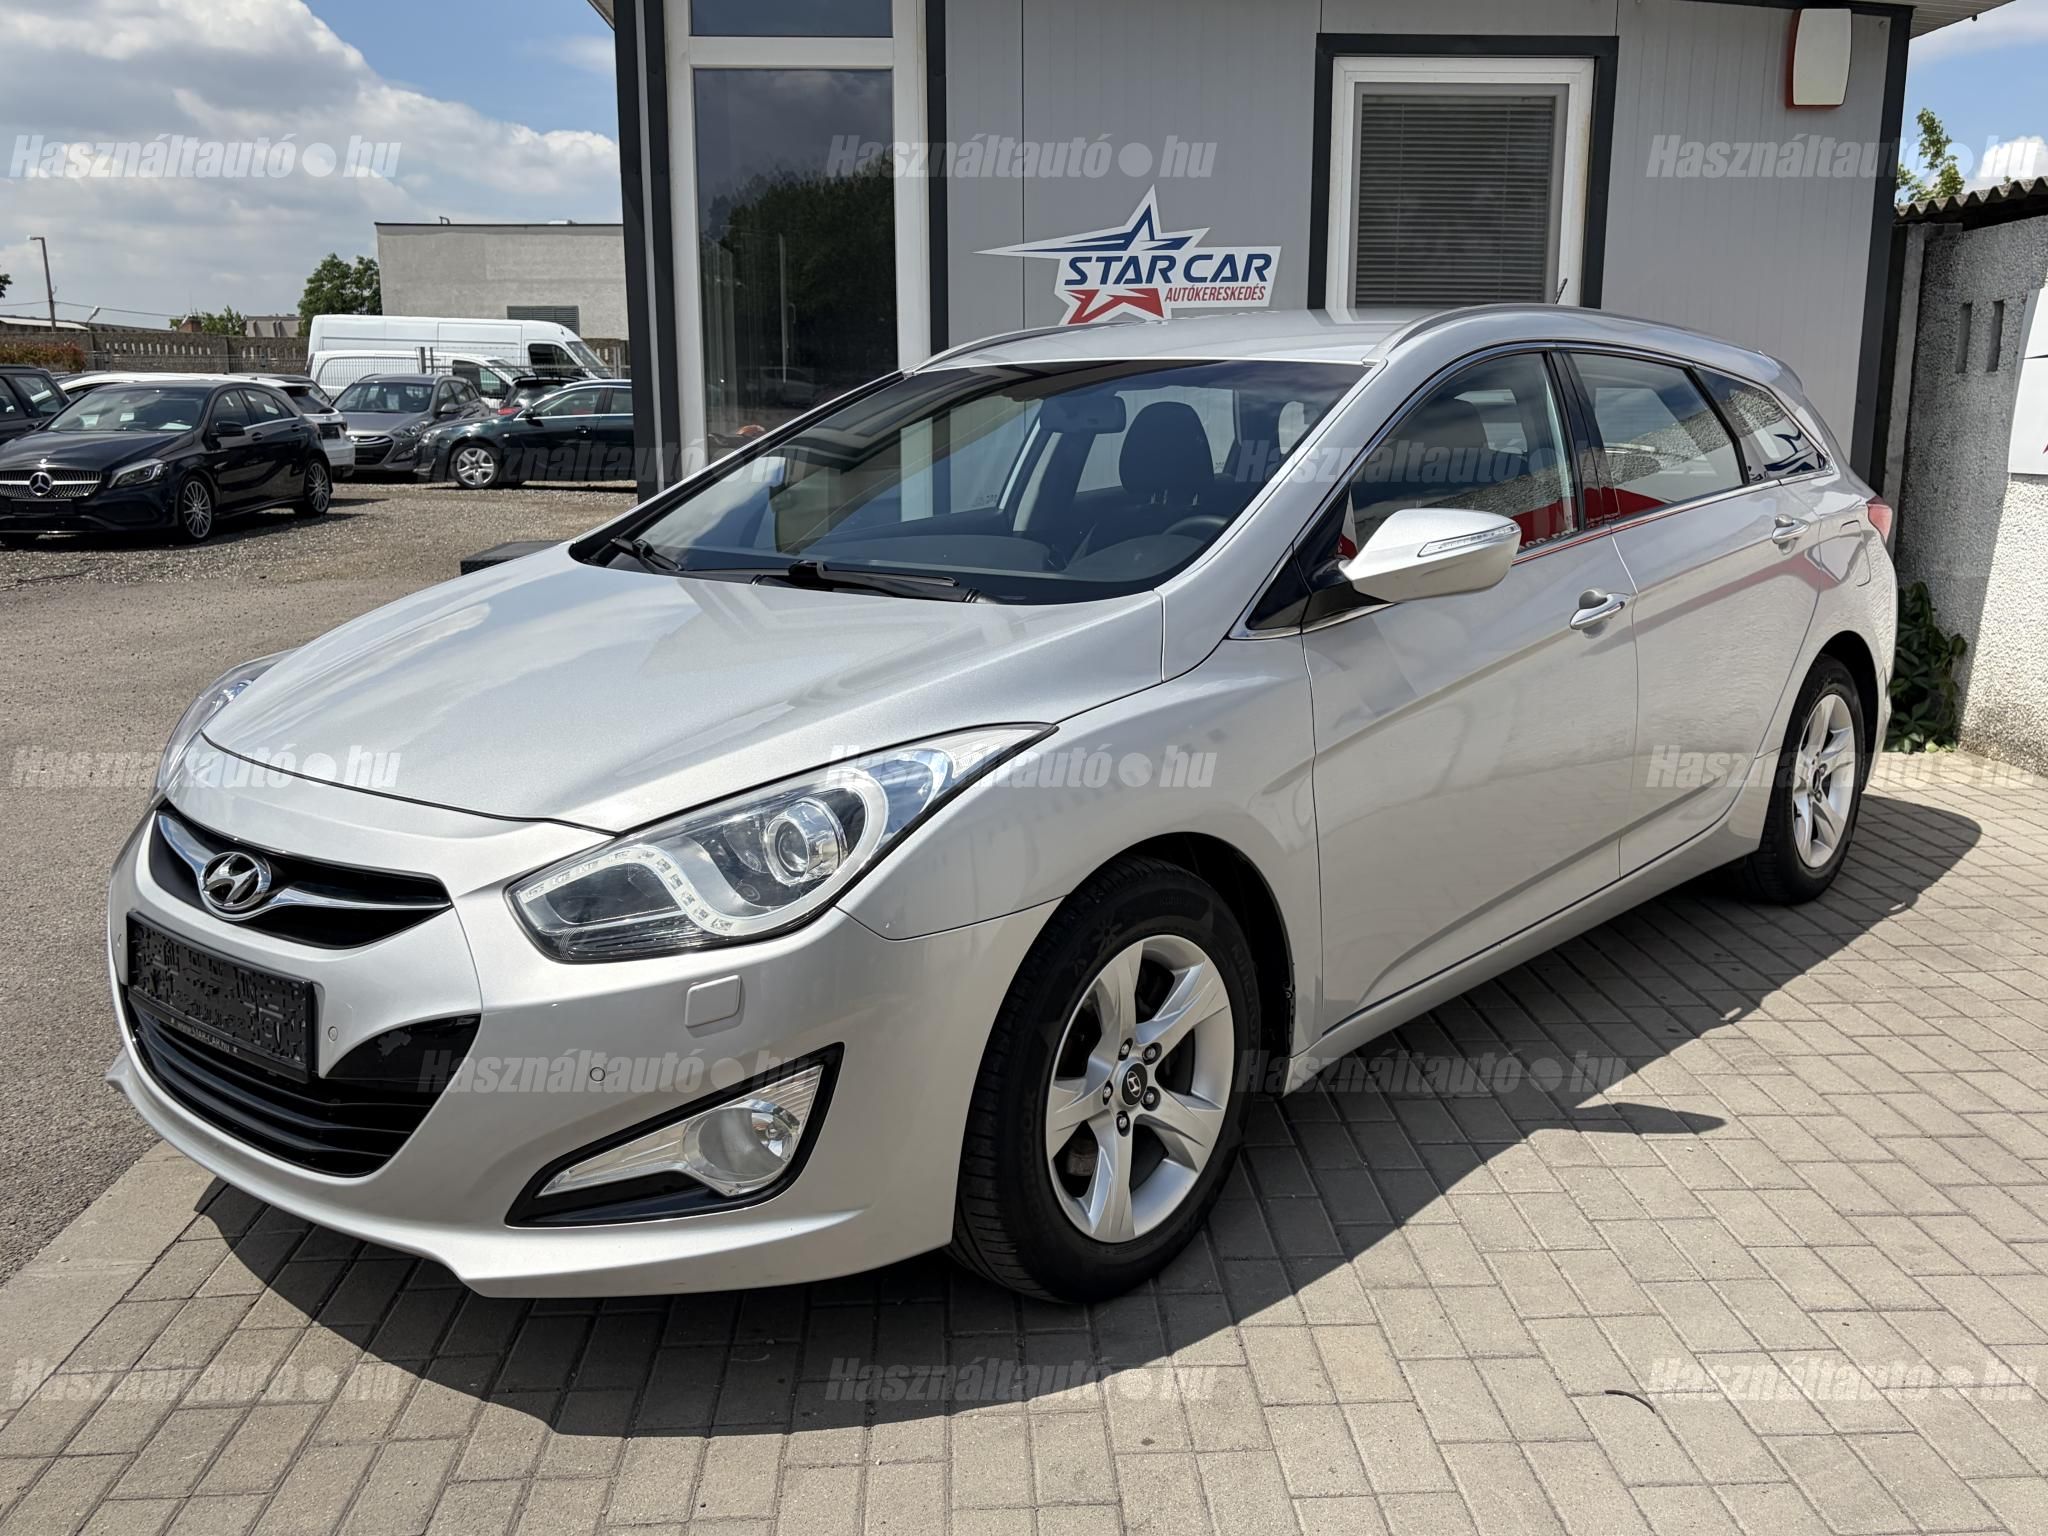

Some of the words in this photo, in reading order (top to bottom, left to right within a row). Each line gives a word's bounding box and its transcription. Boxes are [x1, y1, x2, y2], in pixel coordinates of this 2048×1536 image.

[1064, 254, 1177, 286] STAR
[1182, 253, 1272, 283] CAR
[1164, 284, 1267, 303] AUTÓKERESKEDÉS
